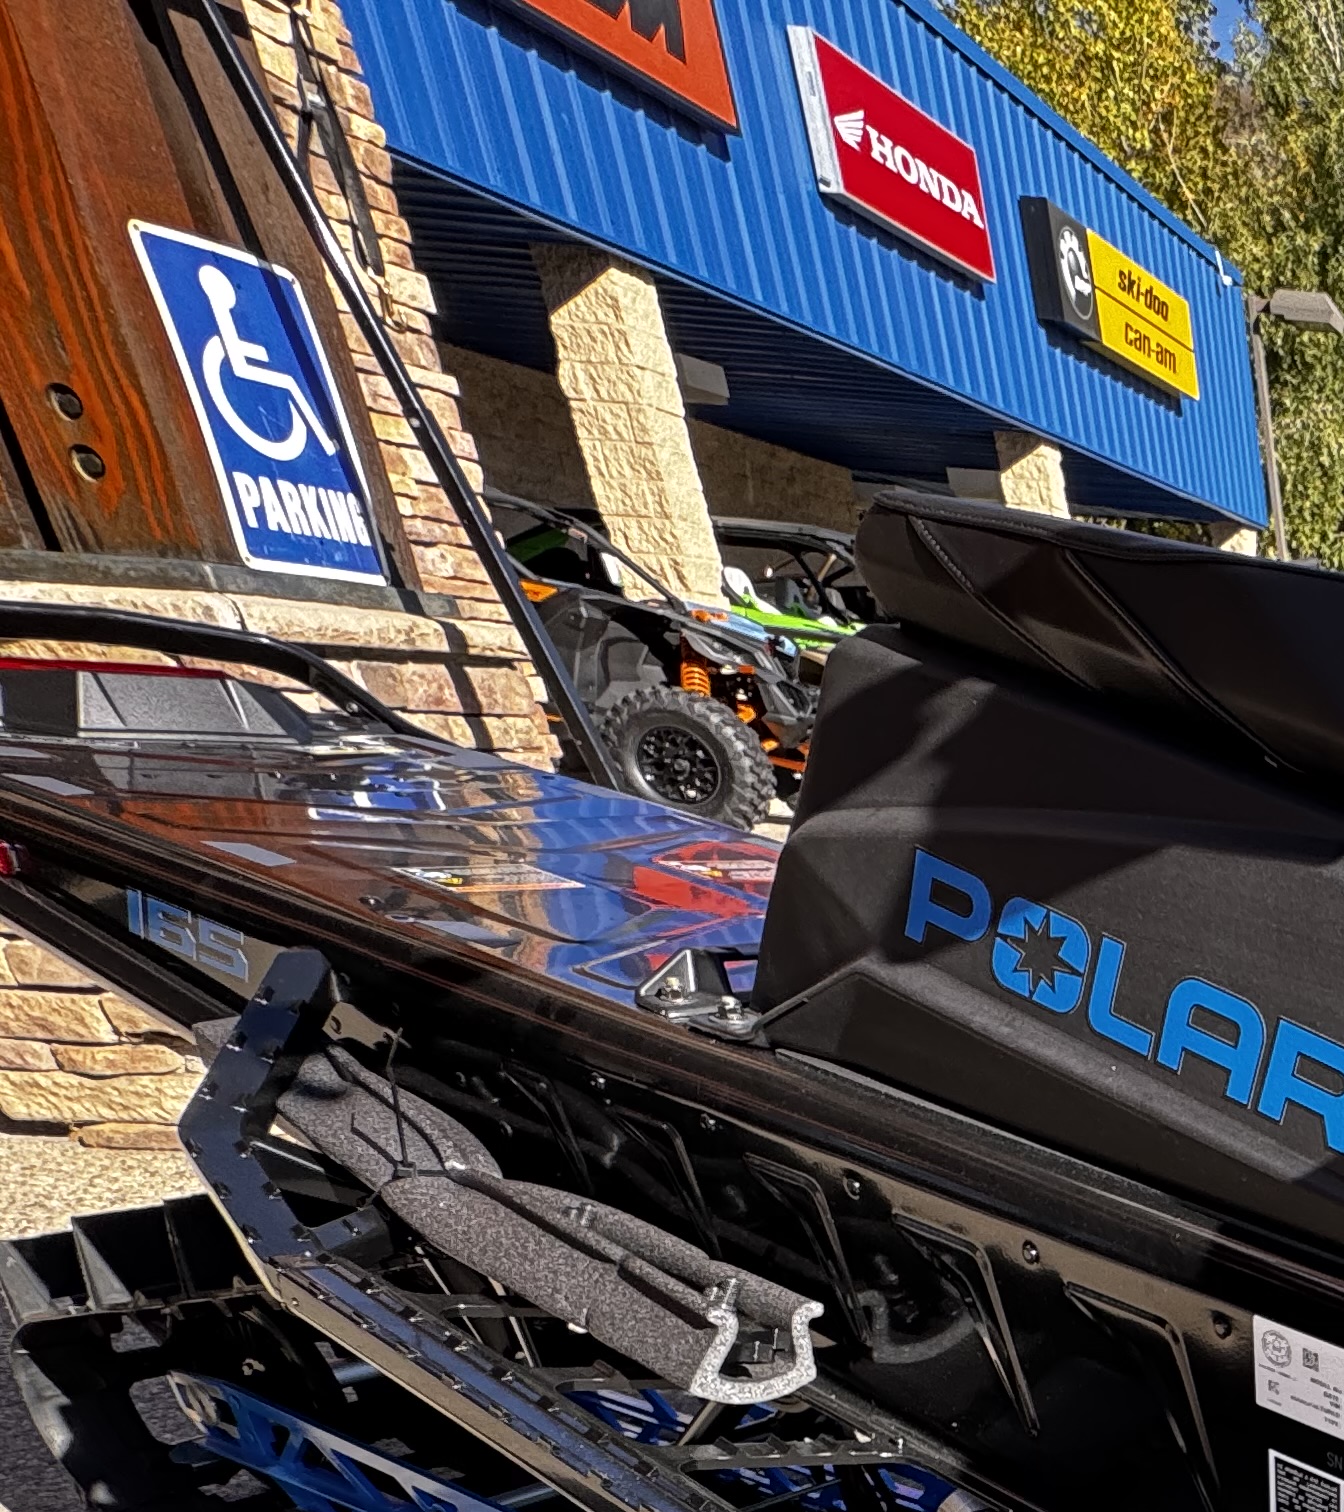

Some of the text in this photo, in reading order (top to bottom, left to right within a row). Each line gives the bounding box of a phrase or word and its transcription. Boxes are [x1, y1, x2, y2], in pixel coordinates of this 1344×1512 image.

[866, 125, 984, 229] HONDA
[1118, 269, 1169, 322] ski-doo
[1125, 322, 1176, 374] can-am
[232, 471, 372, 547] PARKING
[126, 886, 249, 983] 165
